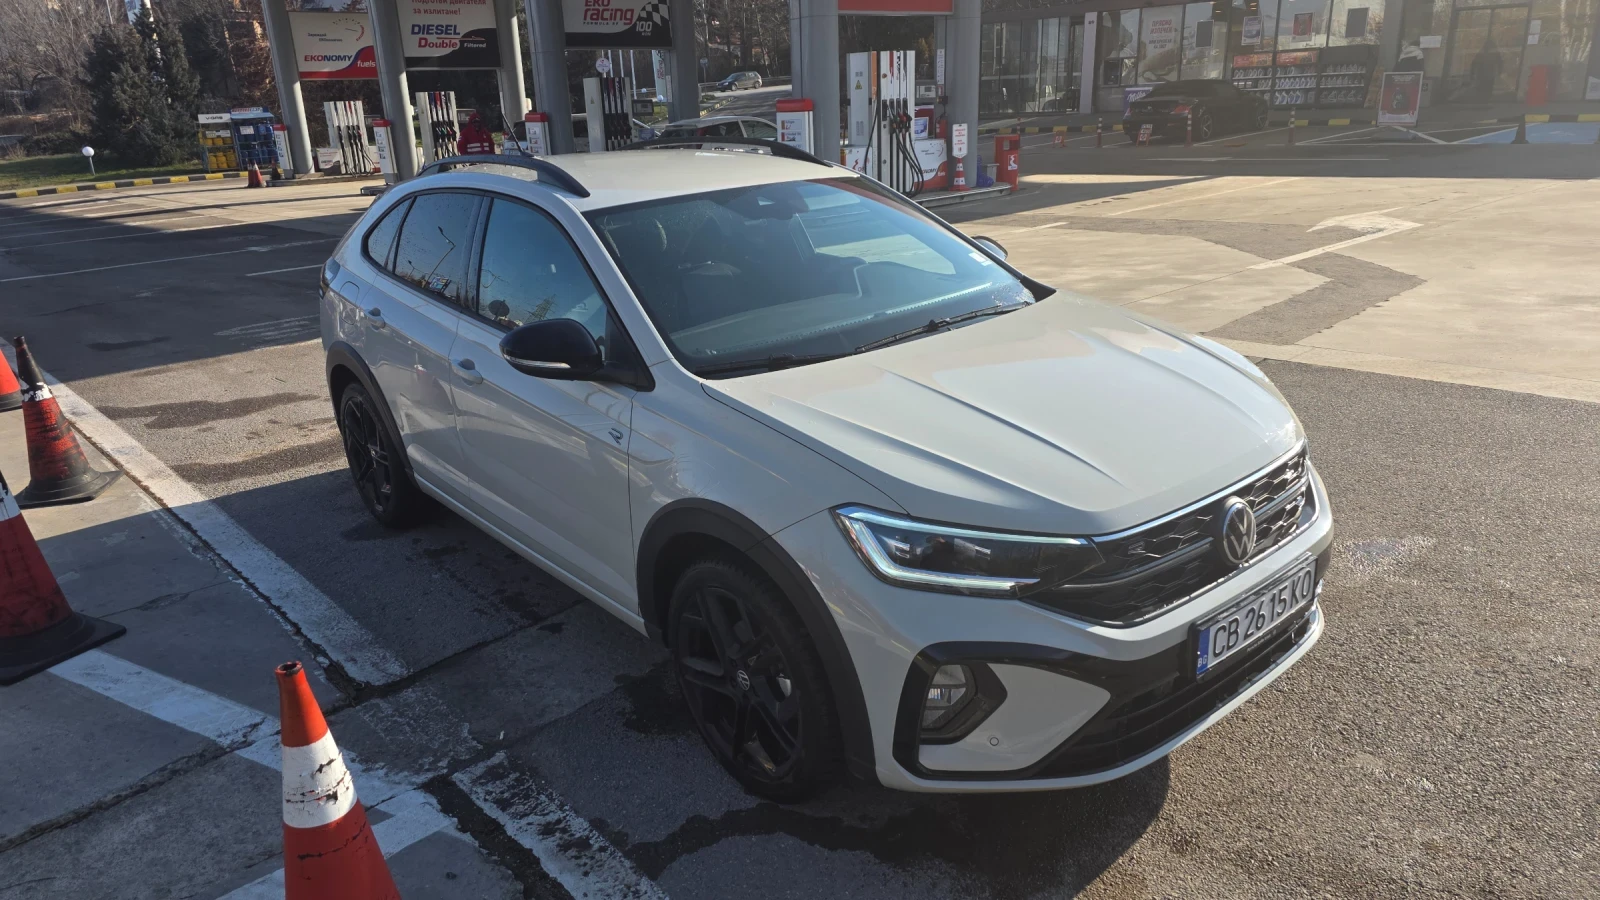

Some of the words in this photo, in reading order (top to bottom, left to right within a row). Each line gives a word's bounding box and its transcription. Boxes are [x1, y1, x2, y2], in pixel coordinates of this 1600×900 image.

[583, 8, 635, 26] racing
[411, 24, 460, 36] DIESEL
[636, 21, 652, 32] 100
[418, 37, 458, 49] Double
[1212, 616, 1240, 658] CB
[1243, 582, 1289, 641] 2615
[1289, 569, 1312, 609] KO
[1197, 655, 1208, 667] BG
